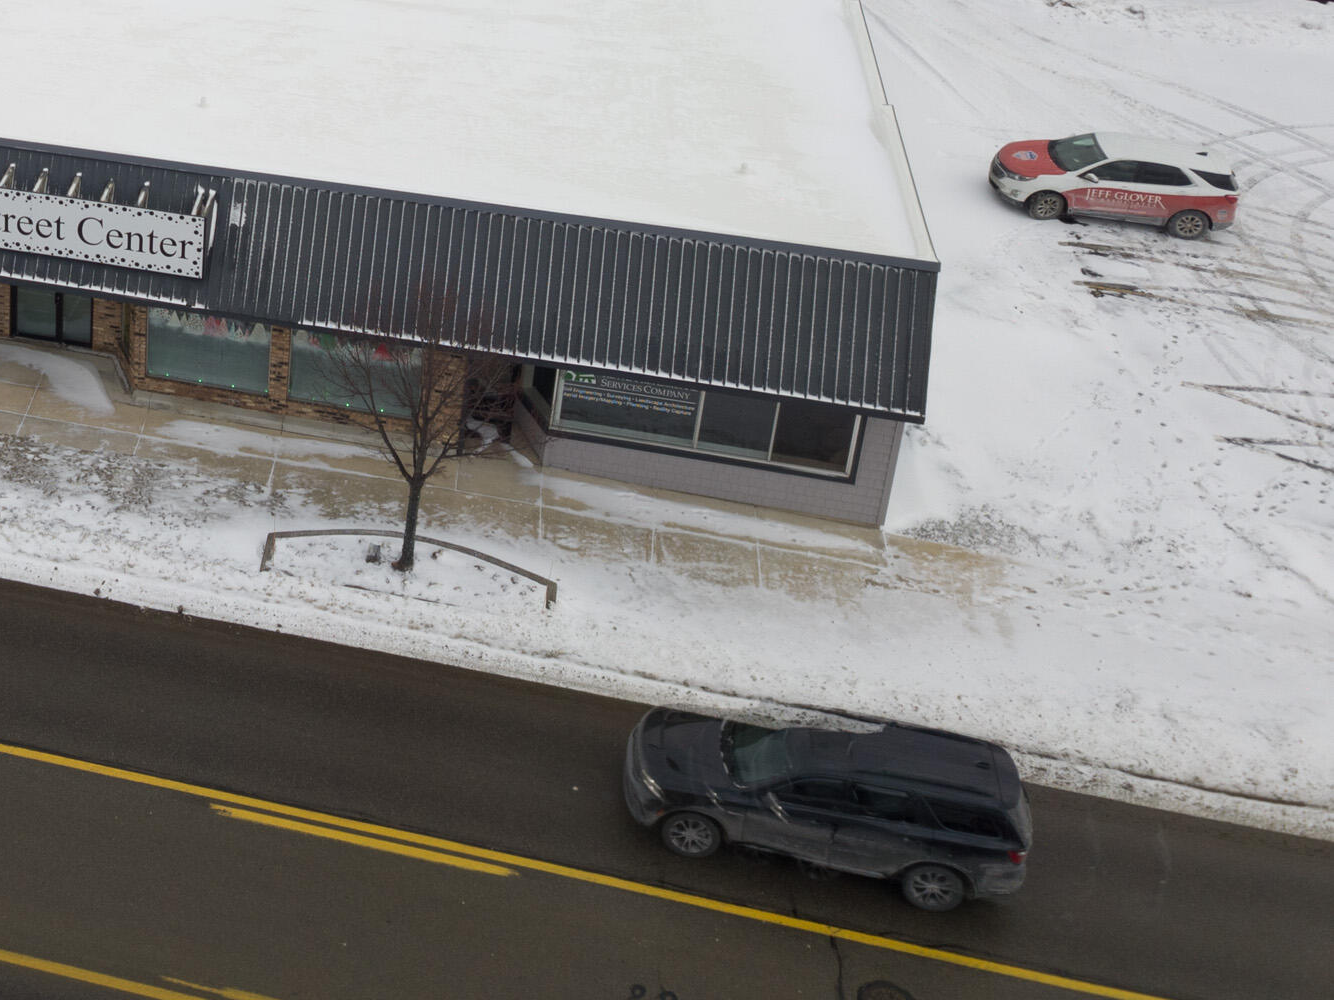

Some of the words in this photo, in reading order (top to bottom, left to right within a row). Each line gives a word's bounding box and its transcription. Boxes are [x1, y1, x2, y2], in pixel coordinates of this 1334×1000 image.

[1086, 188, 1112, 200] JEFF
[1114, 191, 1166, 210] GLOVER
[77, 216, 194, 260] Center
[600, 378, 642, 392] SERVICES
[643, 385, 691, 400] COMPANY
